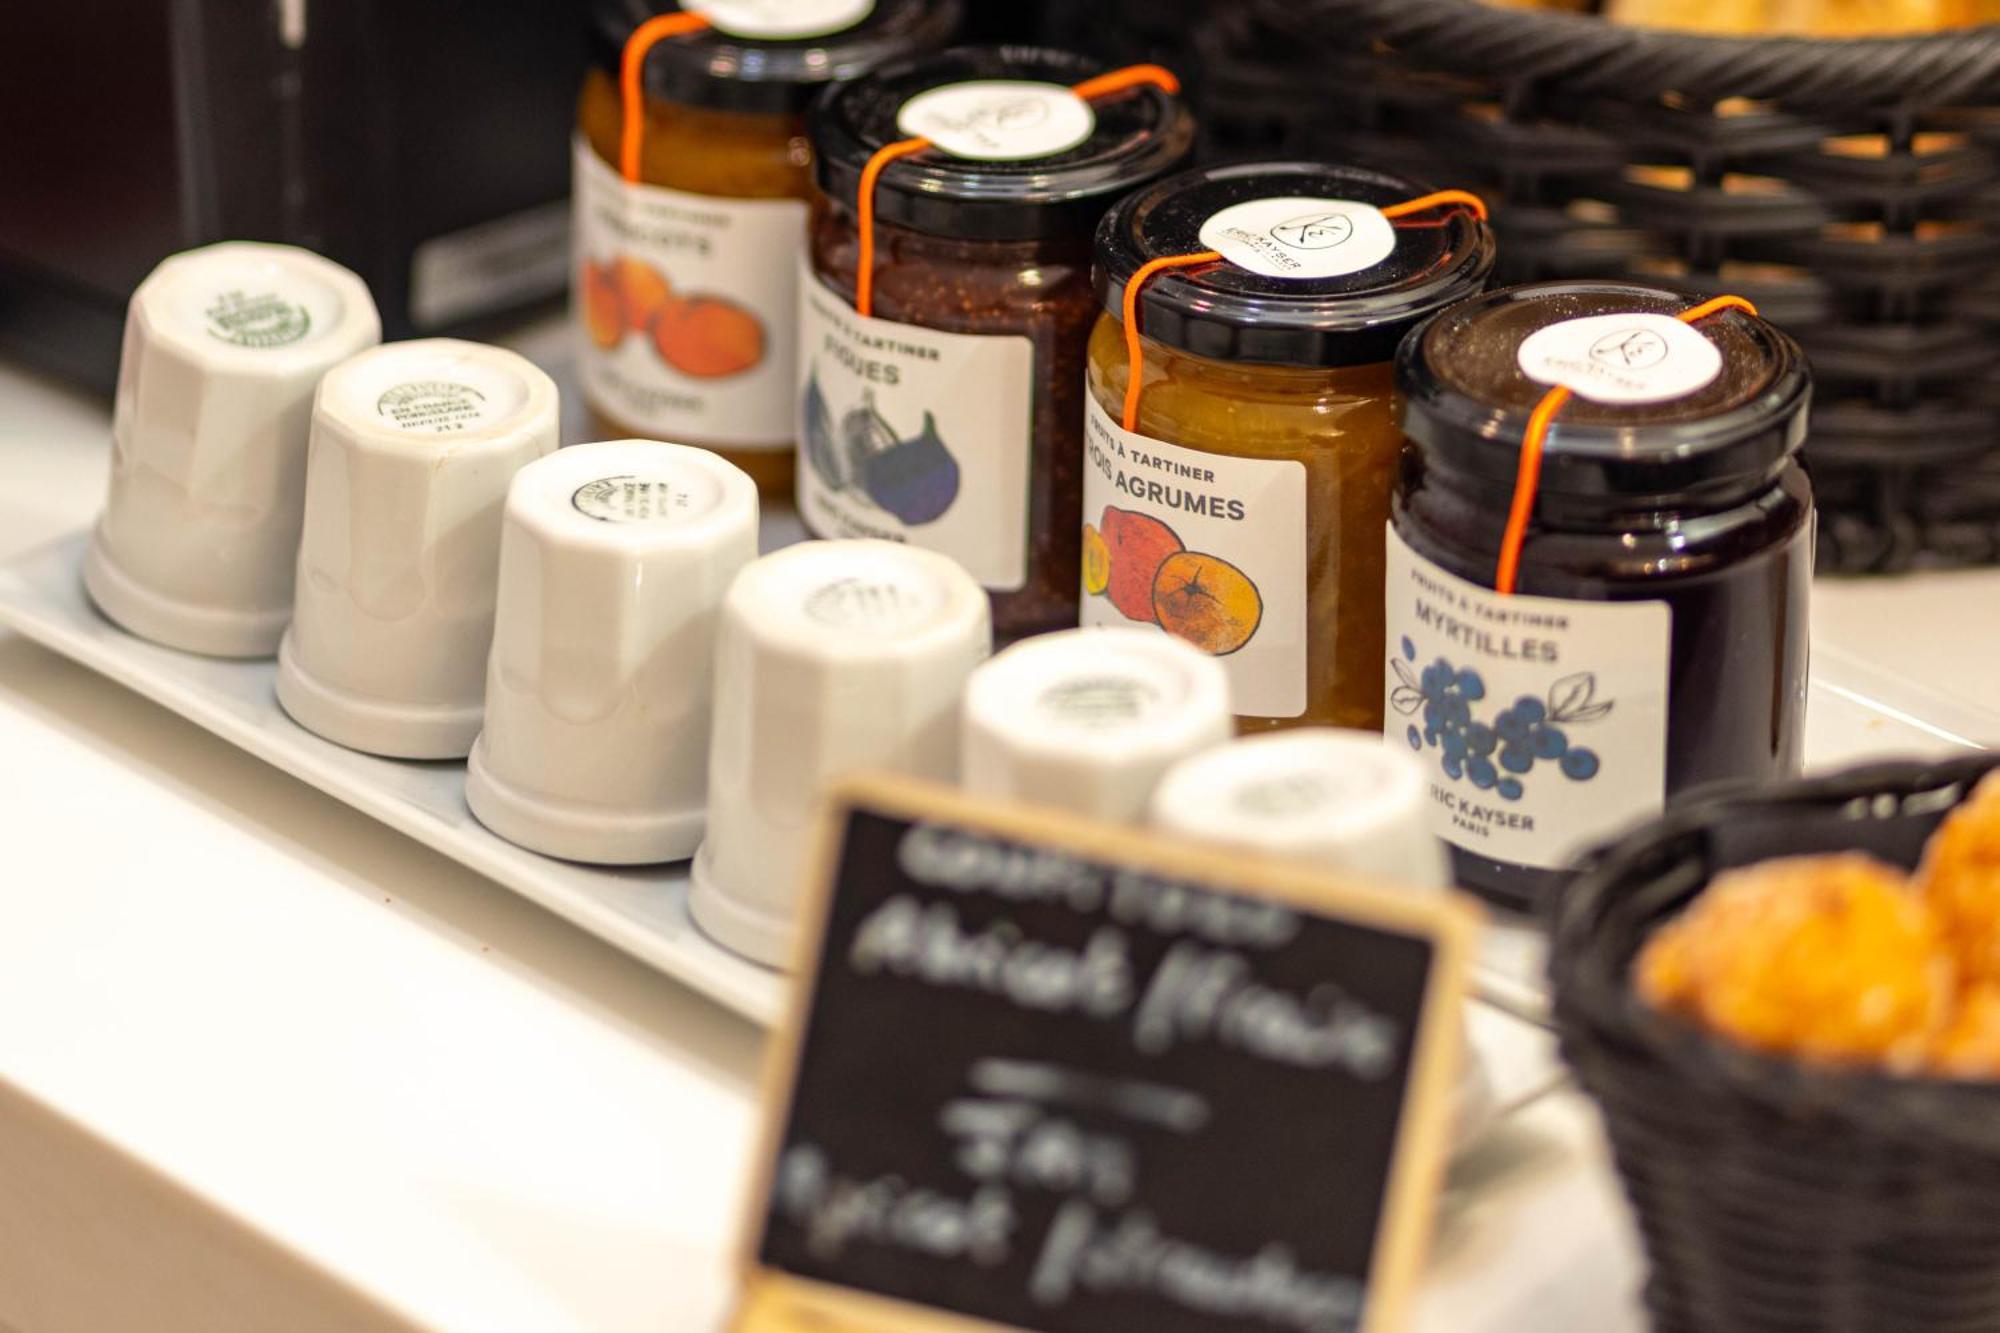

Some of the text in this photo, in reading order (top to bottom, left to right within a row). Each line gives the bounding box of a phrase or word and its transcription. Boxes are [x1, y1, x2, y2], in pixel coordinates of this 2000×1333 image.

[1254, 236, 1302, 269] KAYSER
[824, 333, 901, 385] FIGUES
[1130, 449, 1216, 483] TARTINER
[1115, 472, 1246, 521] AGRUMES
[1410, 568, 1456, 604] FRUITS
[1474, 602, 1571, 631] TARTINER
[1415, 598, 1559, 662] MYRTILLES
[1452, 814, 1490, 838] PARIS
[1458, 798, 1535, 832] KAYSER
